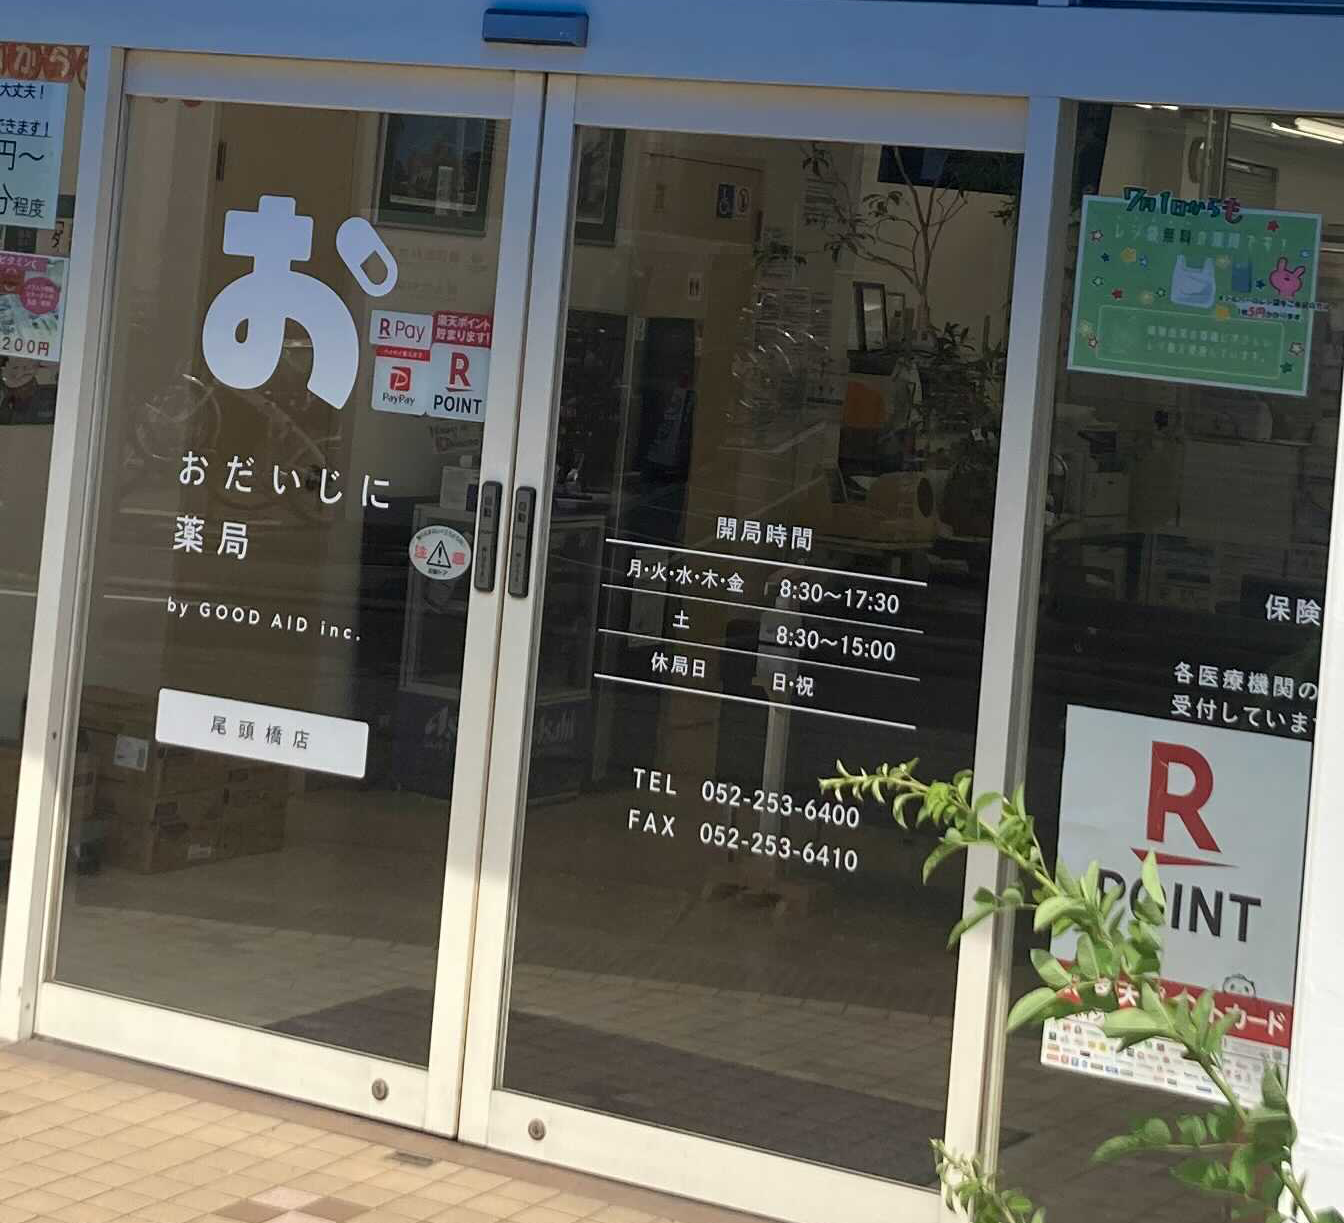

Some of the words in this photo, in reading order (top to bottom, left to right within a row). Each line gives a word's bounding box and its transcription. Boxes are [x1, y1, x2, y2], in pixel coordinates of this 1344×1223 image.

[2, 336, 50, 356] 200円
[395, 320, 426, 342] Pay
[382, 392, 416, 407] PayPay
[433, 394, 483, 415] POINT
[178, 450, 391, 509] おだいじに
[172, 514, 249, 561] 薬局
[716, 516, 814, 552] 開局時間
[626, 558, 745, 594] 月・火・水・木・金
[167, 596, 189, 618] by
[199, 601, 261, 625] GOOD
[271, 614, 308, 633] AID
[320, 620, 361, 642] inc.
[672, 610, 691, 630] 土
[1264, 593, 1323, 627] 保険
[651, 651, 707, 678] 休局日
[771, 673, 815, 698] 日・祝
[1173, 661, 1319, 701] 各医療機関の
[210, 714, 312, 750] 尾頭橋店
[1170, 693, 1318, 734] 受付していま
[632, 767, 678, 796] TEL
[701, 779, 860, 829] 052-253-6400
[627, 808, 676, 838] FAX
[699, 821, 859, 873] 052-253-6410
[1098, 868, 1263, 943] POINT
